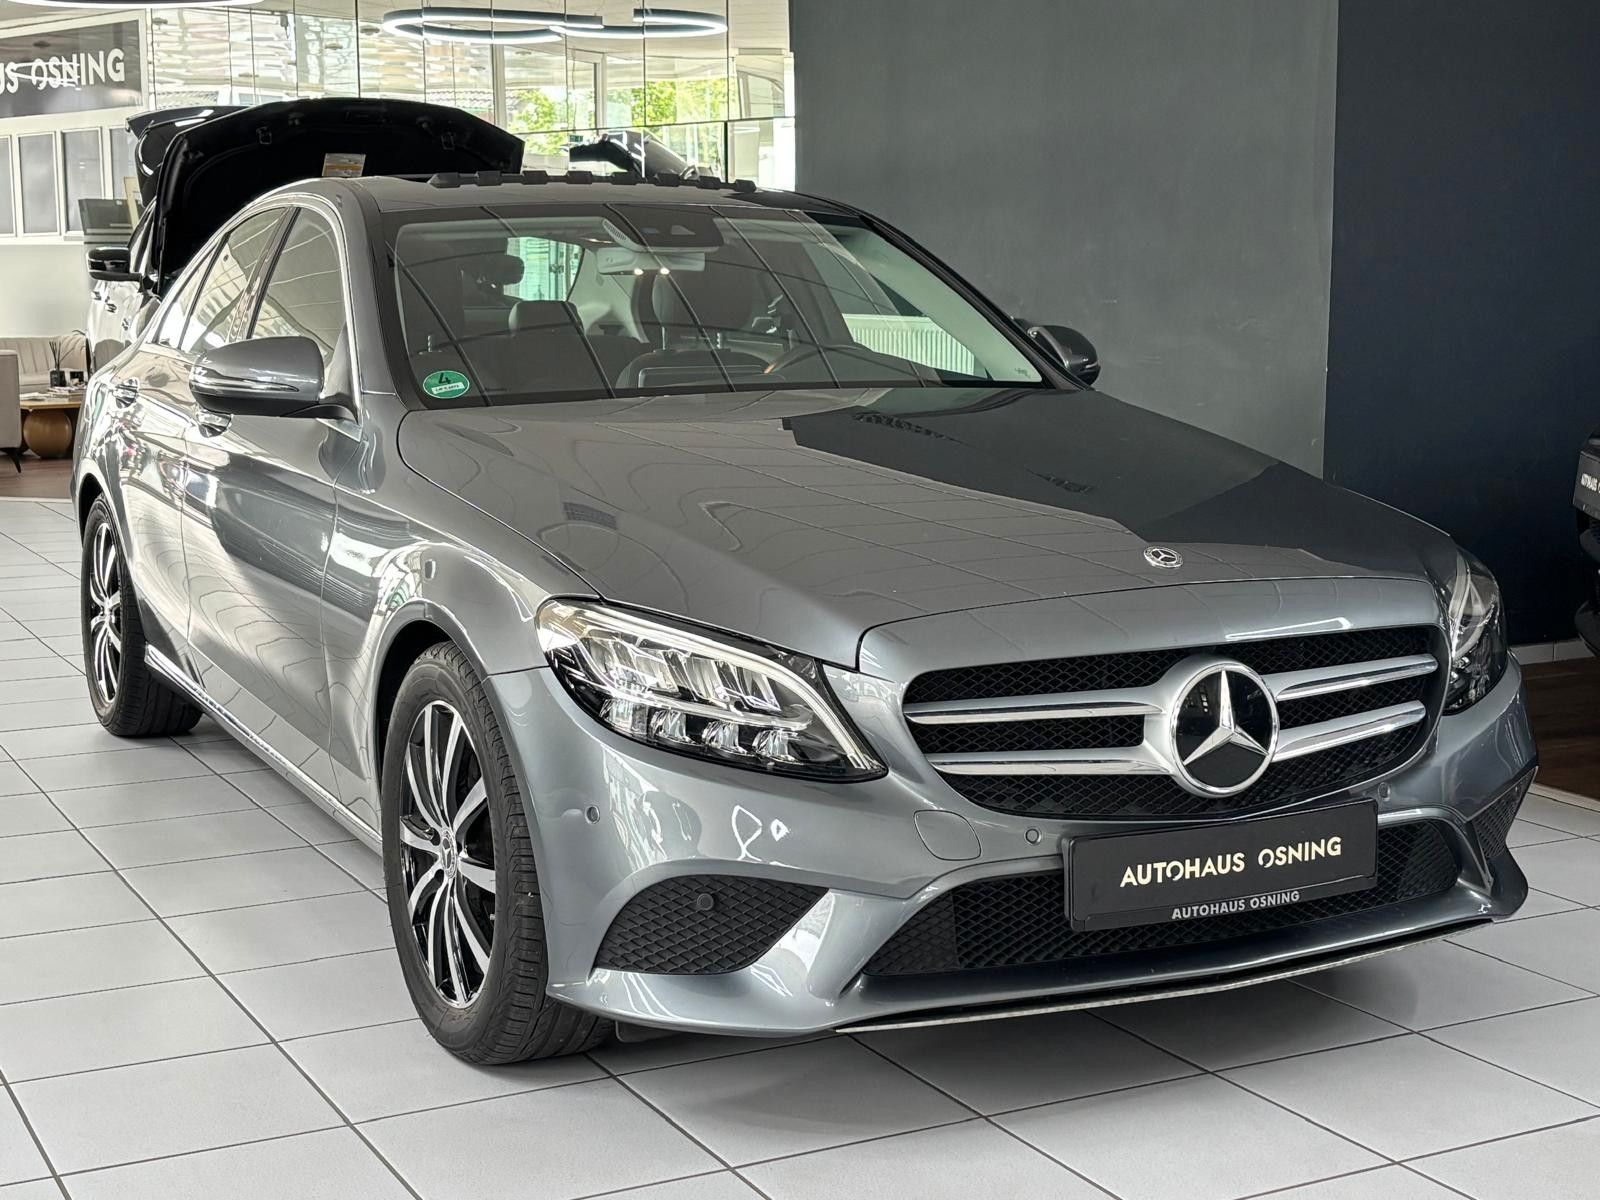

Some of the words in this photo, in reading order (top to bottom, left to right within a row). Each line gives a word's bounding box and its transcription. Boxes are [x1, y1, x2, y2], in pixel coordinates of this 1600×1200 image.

[31, 48, 125, 90] OSNING
[438, 372, 452, 384] 4
[1119, 852, 1245, 887] AUTOHAUS
[1257, 836, 1341, 868] OSNING
[1171, 899, 1245, 919] AUTOHAUS
[1250, 890, 1300, 909] OSNING
